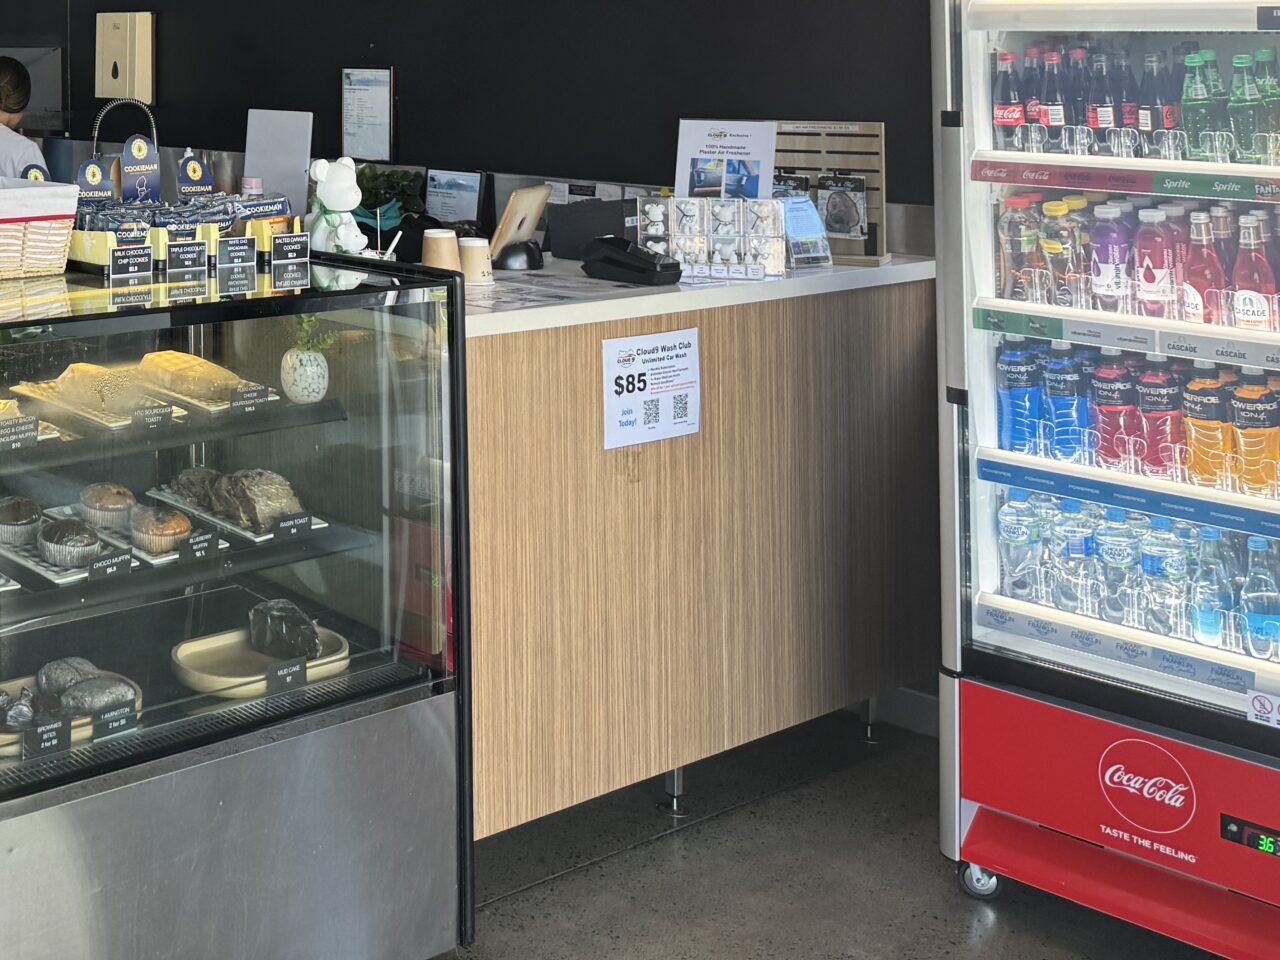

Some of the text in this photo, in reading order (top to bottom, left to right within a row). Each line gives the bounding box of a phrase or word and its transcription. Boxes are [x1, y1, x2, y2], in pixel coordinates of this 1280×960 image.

[993, 107, 1022, 119] oca-Cola
[124, 163, 158, 173] COOKIEMAN
[182, 185, 213, 193] COOKIEMAN
[1163, 178, 1191, 189] Sprite
[1212, 181, 1241, 192] Sprite
[78, 190, 112, 198] COOKIEMAN
[247, 202, 283, 213] COOKIEMAN
[636, 341, 692, 356] Cloud9 Wash Club
[1167, 343, 1198, 354] CASCADE
[641, 356, 666, 364] Unlimited
[1215, 349, 1247, 360] CASCADE
[1265, 355, 1280, 364] CAS
[614, 372, 647, 398] $85
[0, 415, 37, 427] TOASTY BACON
[0, 427, 11, 435] EGG
[16, 423, 35, 432] CHEESE
[279, 517, 308, 528] RAISIN TOAST
[189, 533, 212, 544] BLUEBERRY
[1102, 548, 1133, 557] FRANKLIN
[93, 554, 131, 569] CHOCO MUFFIN
[986, 609, 1015, 623] FRANKLIN
[1027, 620, 1057, 634] FRANKLIN
[1071, 631, 1102, 645] FRANKLIN
[1116, 642, 1148, 657] FRANKLIN
[277, 664, 300, 676] MUD CAKE
[101, 707, 130, 720] LAMINGTON
[37, 721, 62, 733] BROWNIES
[112, 720, 120, 728] for
[42, 731, 57, 740] BITES
[1104, 764, 1190, 808] Coca-Cola
[1099, 824, 1196, 864] TASTE THE FEELING
